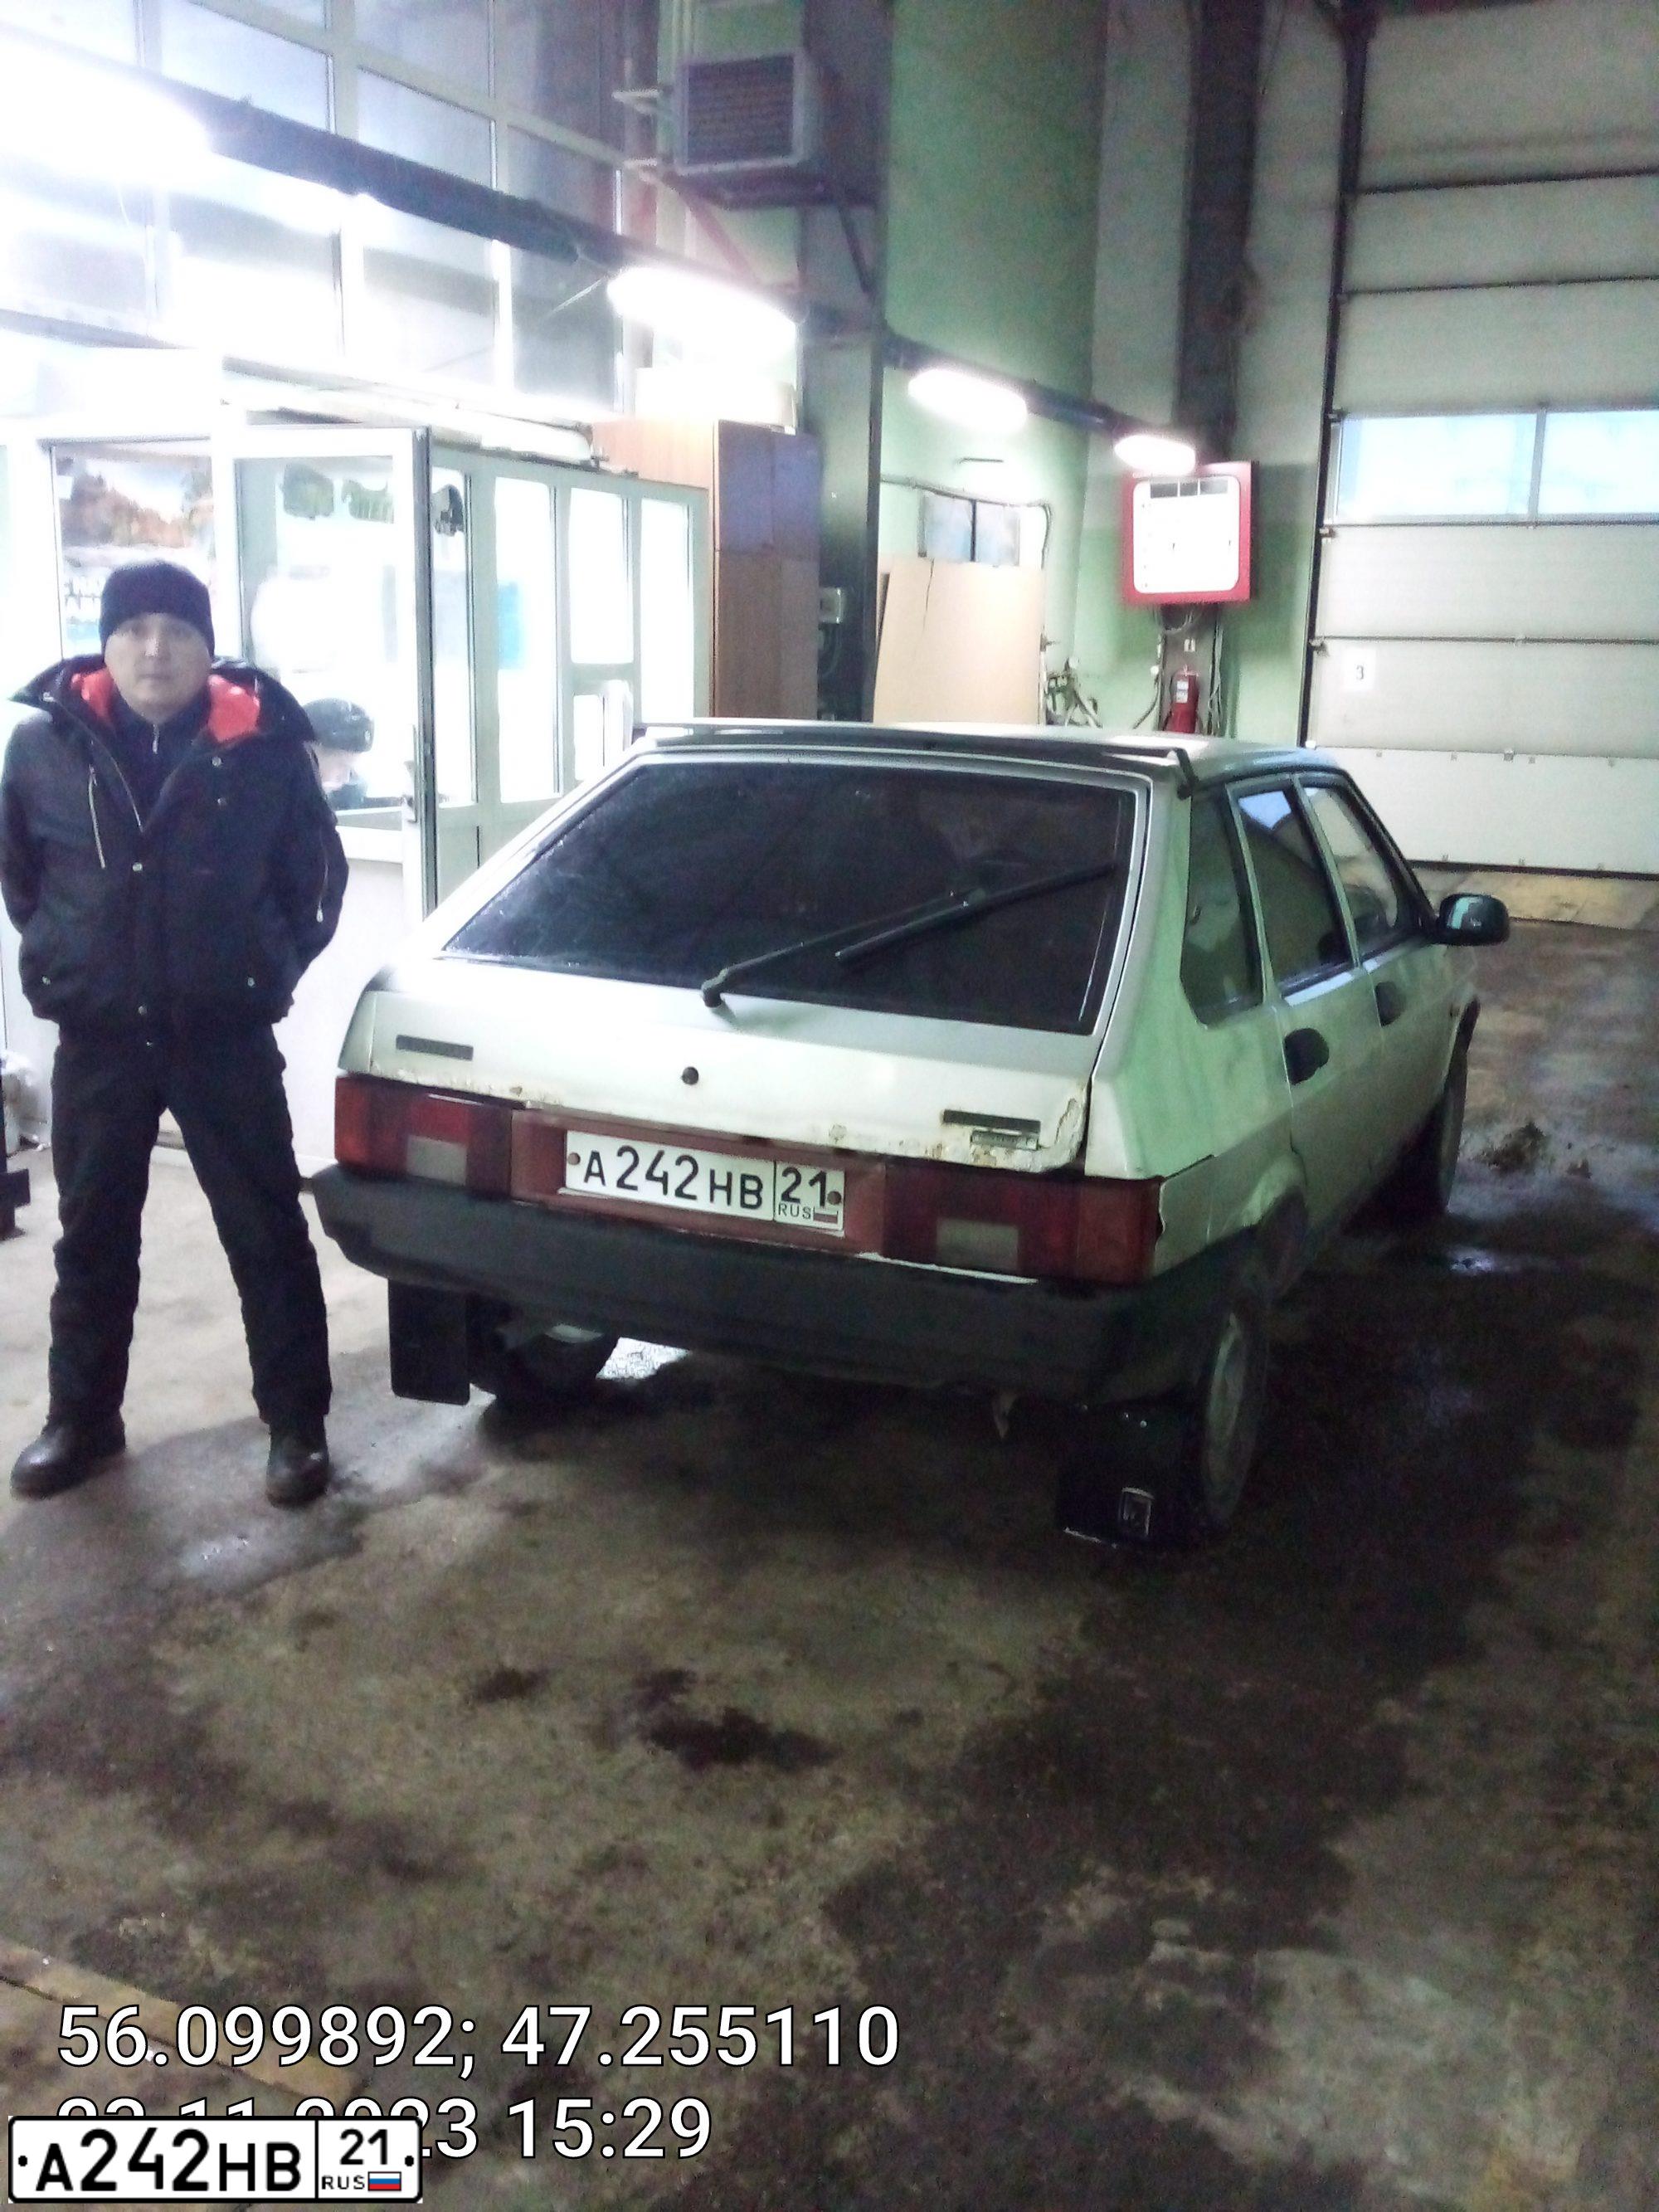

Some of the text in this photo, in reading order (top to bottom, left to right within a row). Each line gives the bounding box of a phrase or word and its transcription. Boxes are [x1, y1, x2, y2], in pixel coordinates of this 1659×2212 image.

[583, 1145, 828, 1211] А242НВ 21
[777, 1203, 811, 1220] RUS
